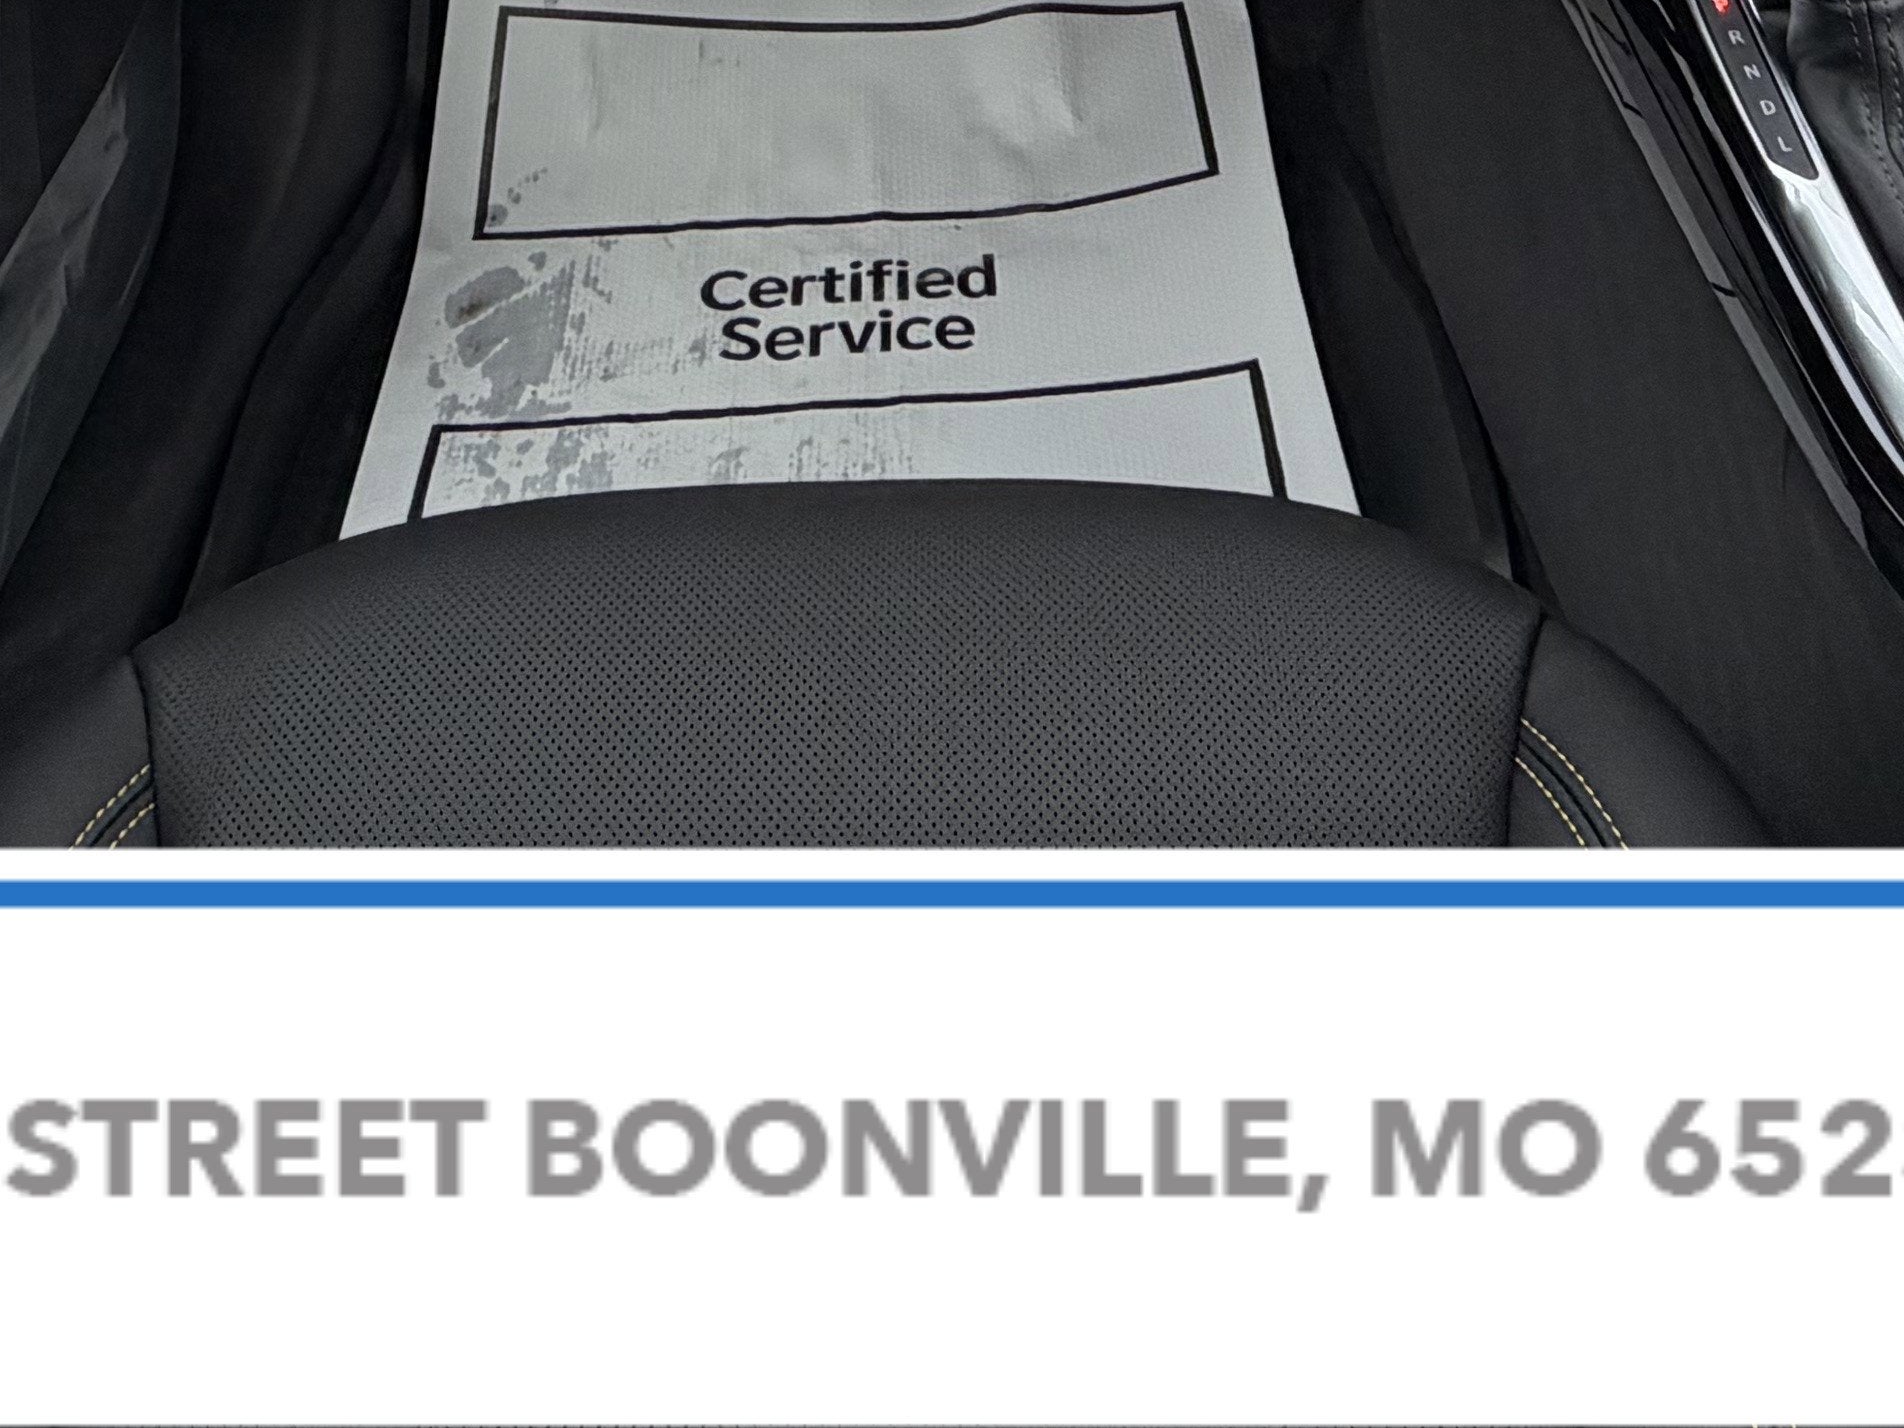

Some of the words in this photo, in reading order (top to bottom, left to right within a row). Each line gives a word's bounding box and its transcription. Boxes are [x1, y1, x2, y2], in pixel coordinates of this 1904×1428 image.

[1728, 29, 1746, 45] R
[1743, 63, 1762, 81] N
[1759, 99, 1777, 116] D
[1777, 135, 1793, 153] L
[700, 253, 997, 312] Certified
[717, 309, 976, 361] Service
